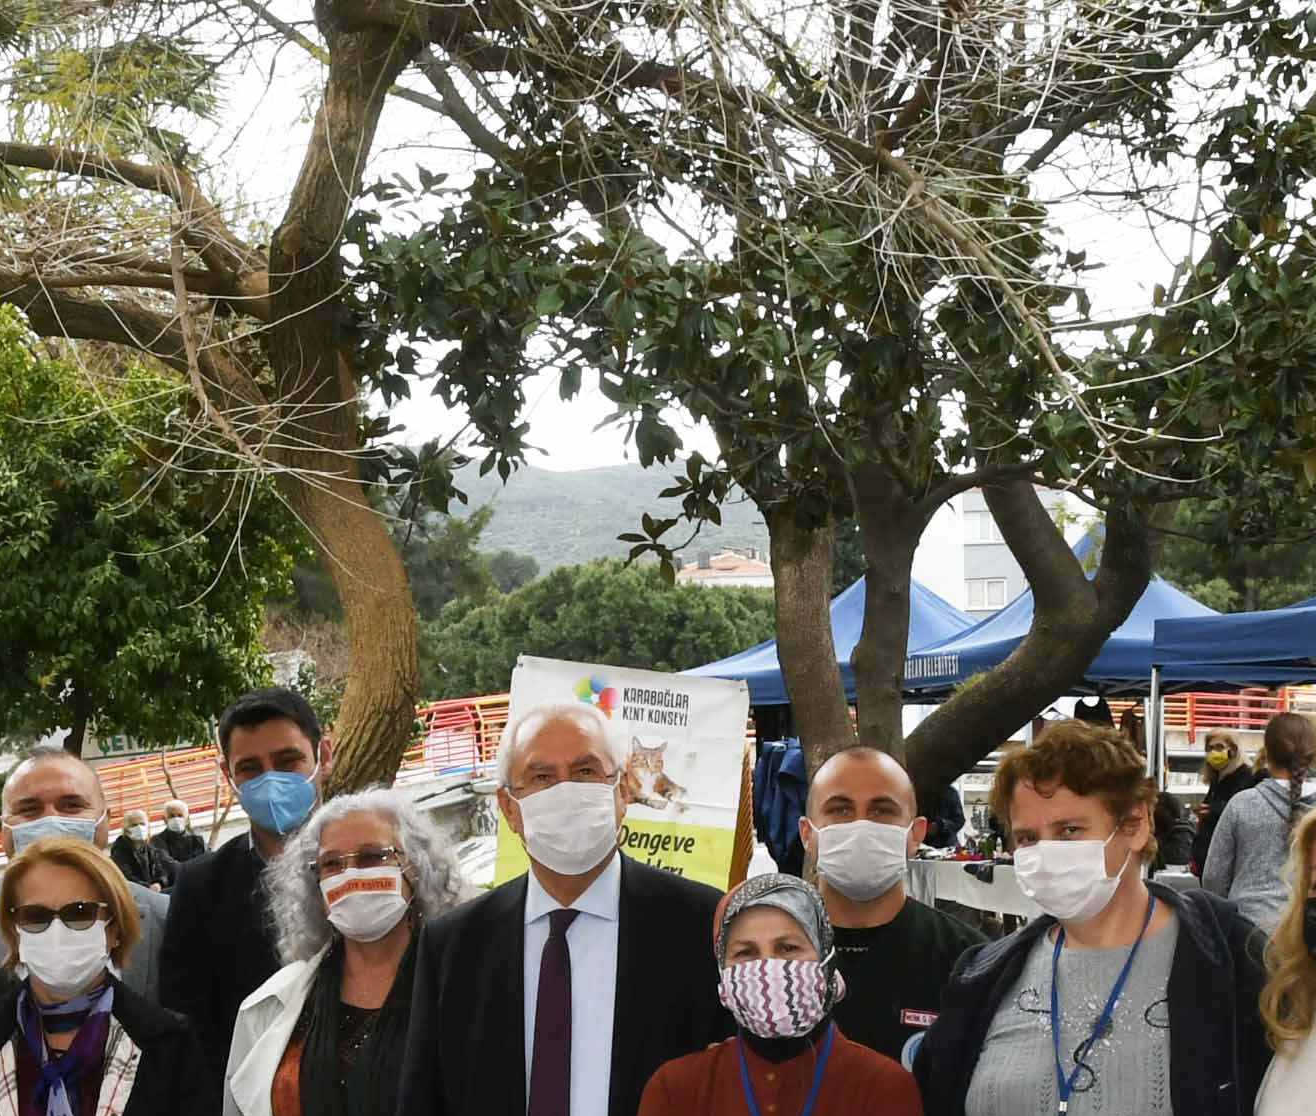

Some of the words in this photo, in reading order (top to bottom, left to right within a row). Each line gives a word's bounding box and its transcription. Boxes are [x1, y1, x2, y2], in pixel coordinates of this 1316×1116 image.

[623, 687, 689, 710] KARABAĞLAR
[622, 706, 644, 721] KENT
[647, 709, 689, 728] KONSEYİ
[618, 824, 671, 856] Denge
[673, 835, 695, 854] ve
